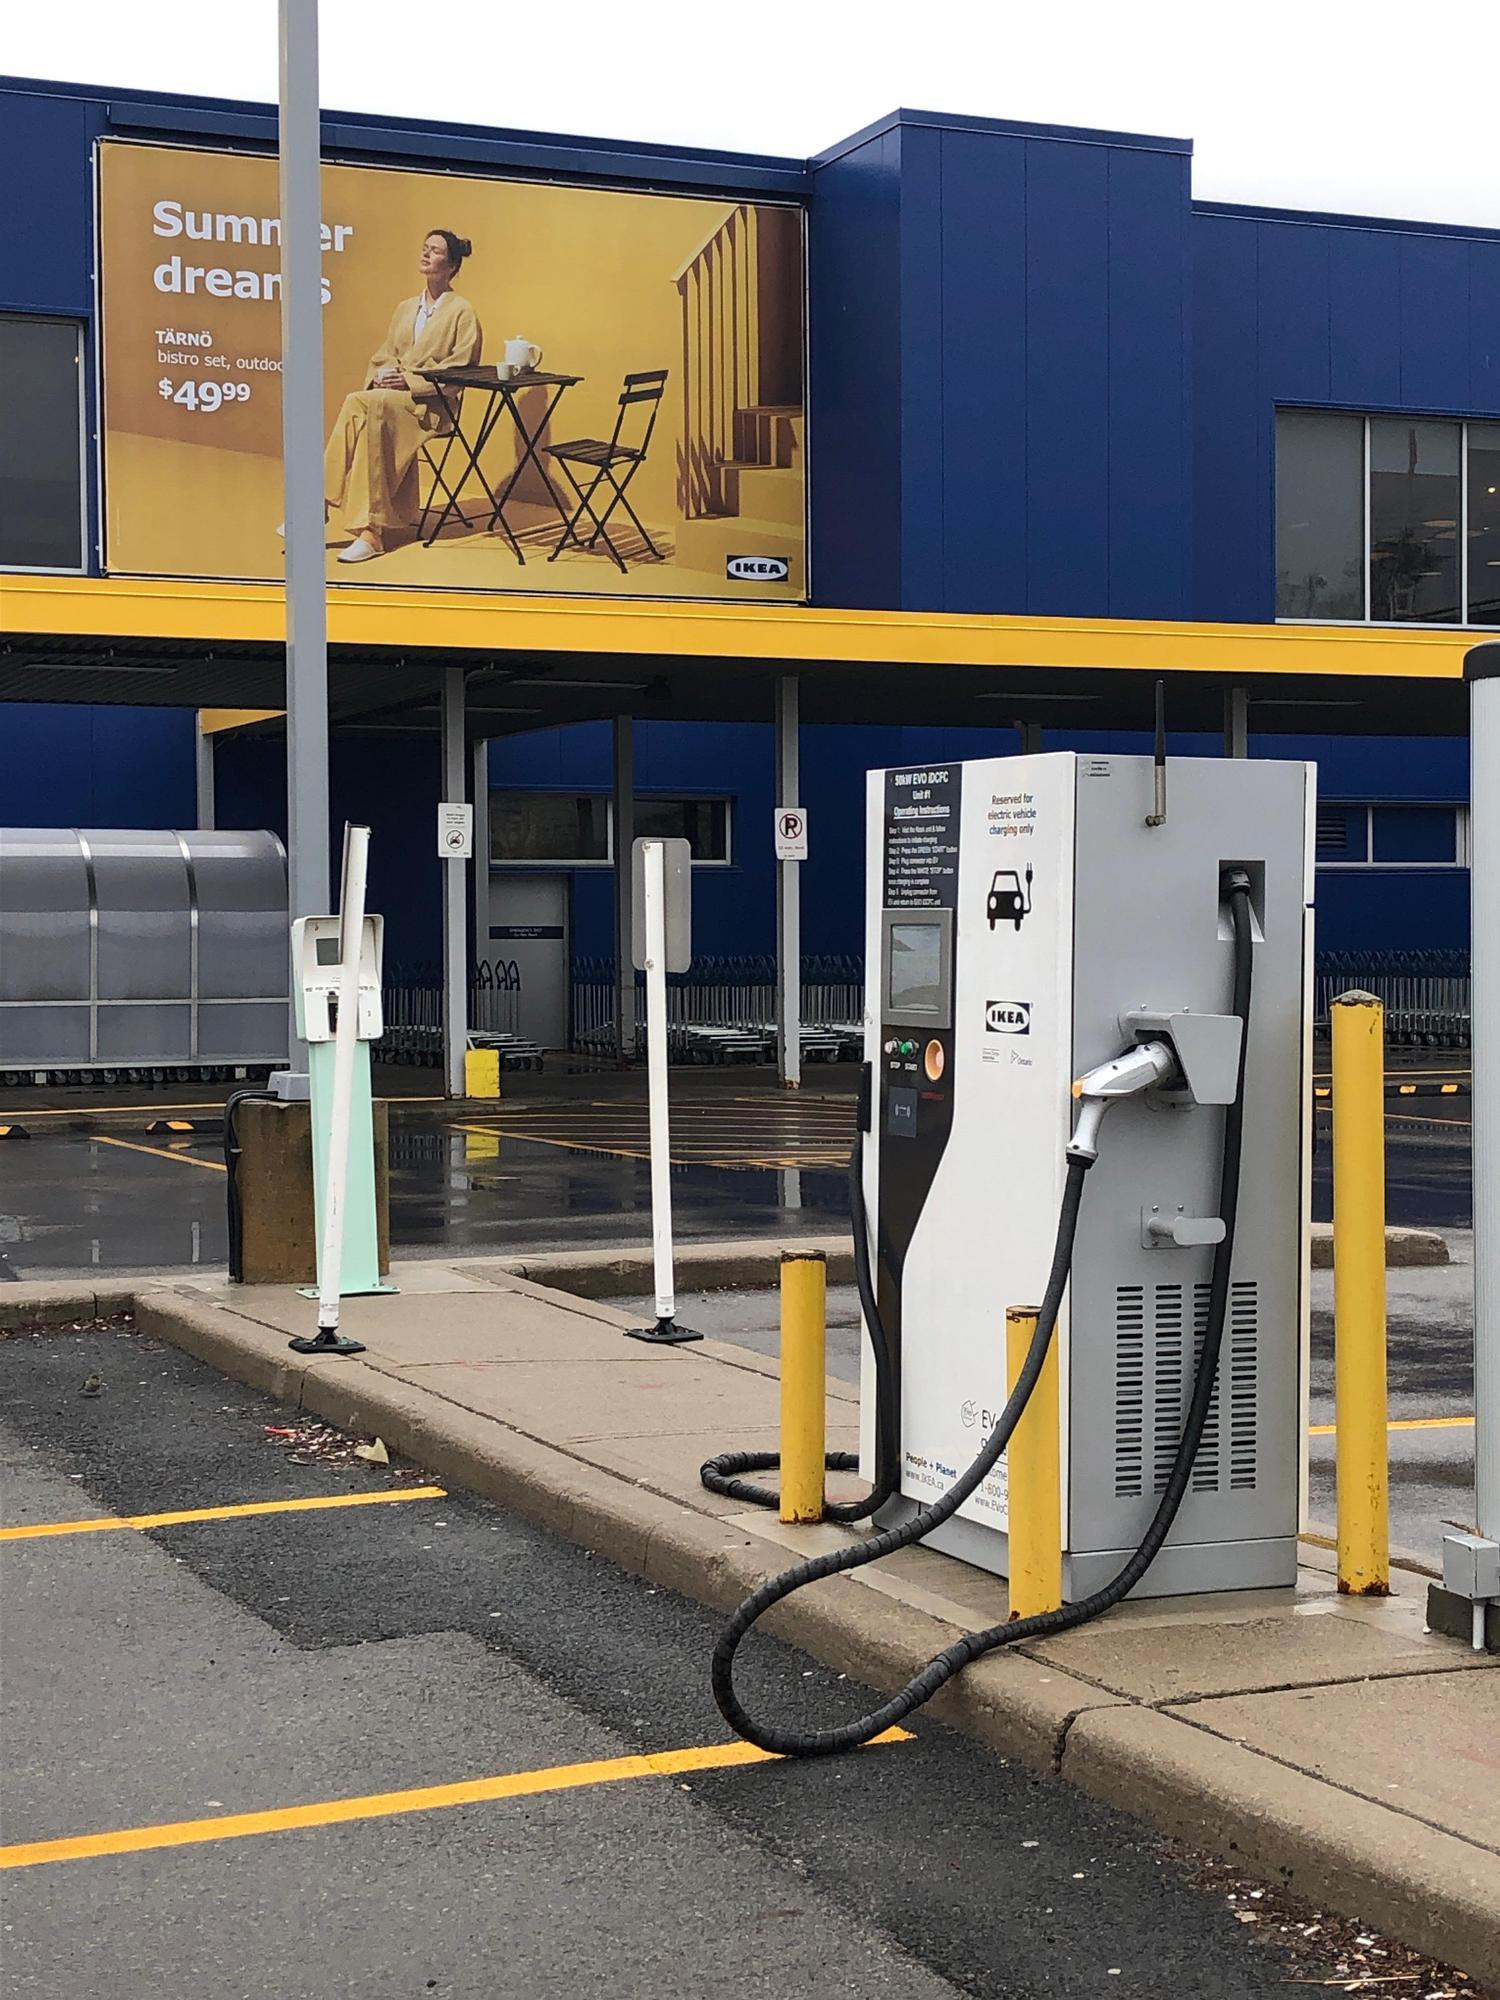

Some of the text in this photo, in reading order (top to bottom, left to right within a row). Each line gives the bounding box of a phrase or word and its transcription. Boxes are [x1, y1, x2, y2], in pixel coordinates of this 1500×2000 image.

[155, 328, 213, 348] TÄRNÖ
[157, 350, 199, 366] bistro
[204, 355, 231, 370] set,
[735, 562, 782, 574] IKEA
[991, 792, 1034, 805] Reserved for
[988, 807, 1037, 820] electric vehicle
[989, 823, 1035, 836] charging only
[991, 1010, 1025, 1024] IKEA
[905, 1452, 928, 1469] People
[935, 1462, 957, 1479] Planet
